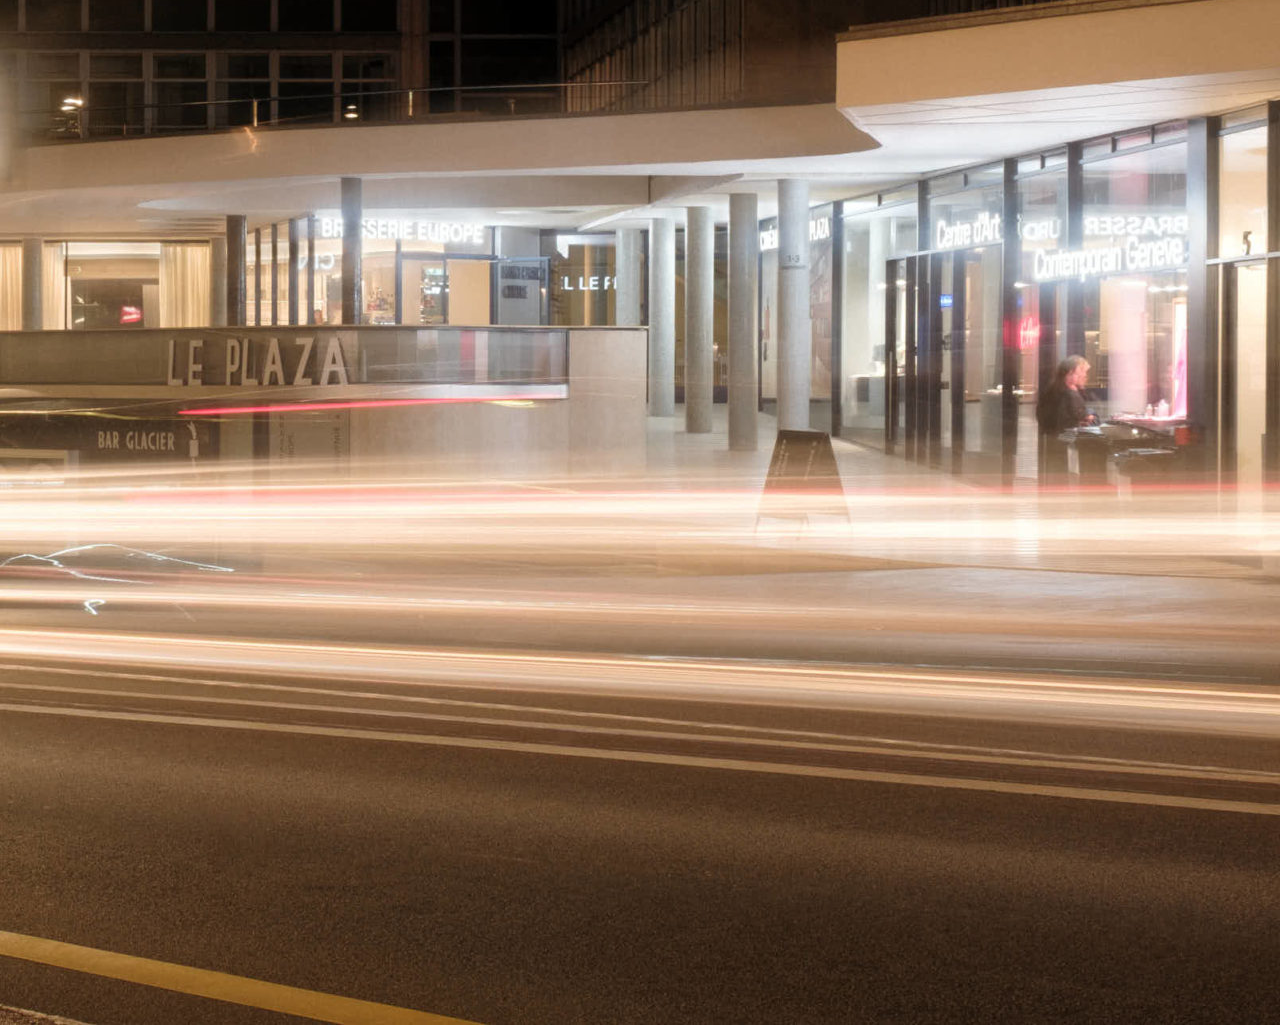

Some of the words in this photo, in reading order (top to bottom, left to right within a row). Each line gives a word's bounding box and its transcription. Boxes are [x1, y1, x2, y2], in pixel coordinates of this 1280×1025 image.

[417, 222, 485, 244] EUROPE
[936, 220, 970, 249] Centre
[578, 276, 599, 290] LE
[167, 338, 204, 386] LE
[225, 336, 349, 386] PLAZA
[97, 430, 120, 451] BAR
[125, 430, 176, 451] GLACIER
